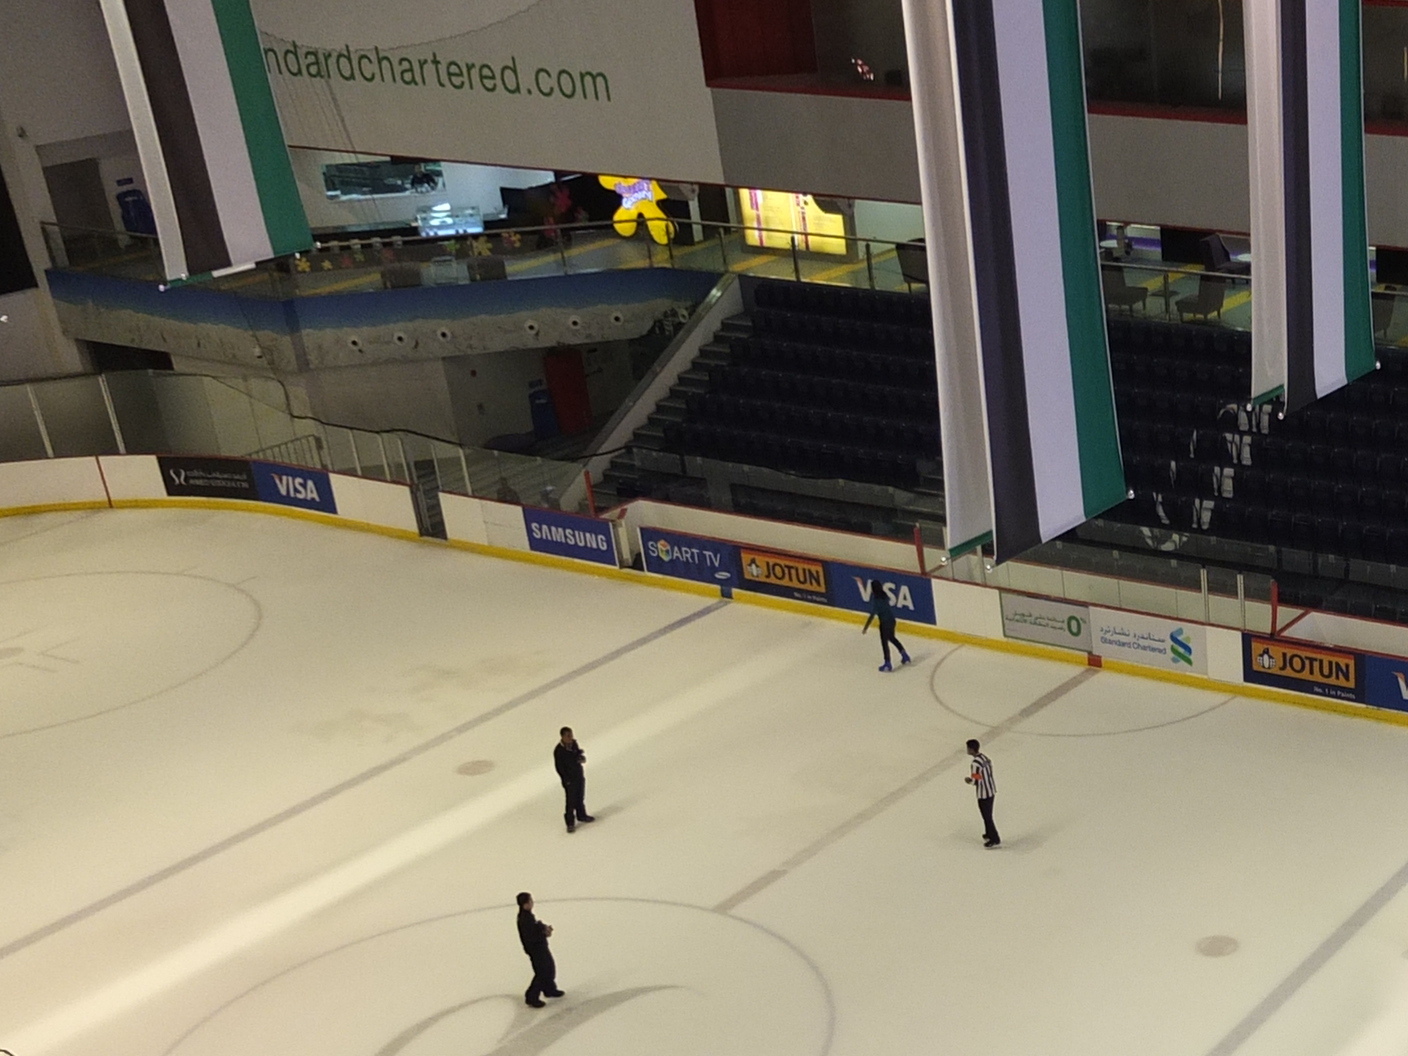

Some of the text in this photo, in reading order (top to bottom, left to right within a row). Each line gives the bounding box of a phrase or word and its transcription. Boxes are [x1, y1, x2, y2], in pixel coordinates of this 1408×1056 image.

[271, 473, 320, 502] VISA
[530, 522, 608, 551] SAMSUNG
[648, 539, 721, 568] SART TV
[764, 561, 822, 588] JOTUN
[851, 575, 915, 611] VSA
[1100, 636, 1166, 655] Standard Chartered
[1279, 652, 1350, 683] JOTUN
